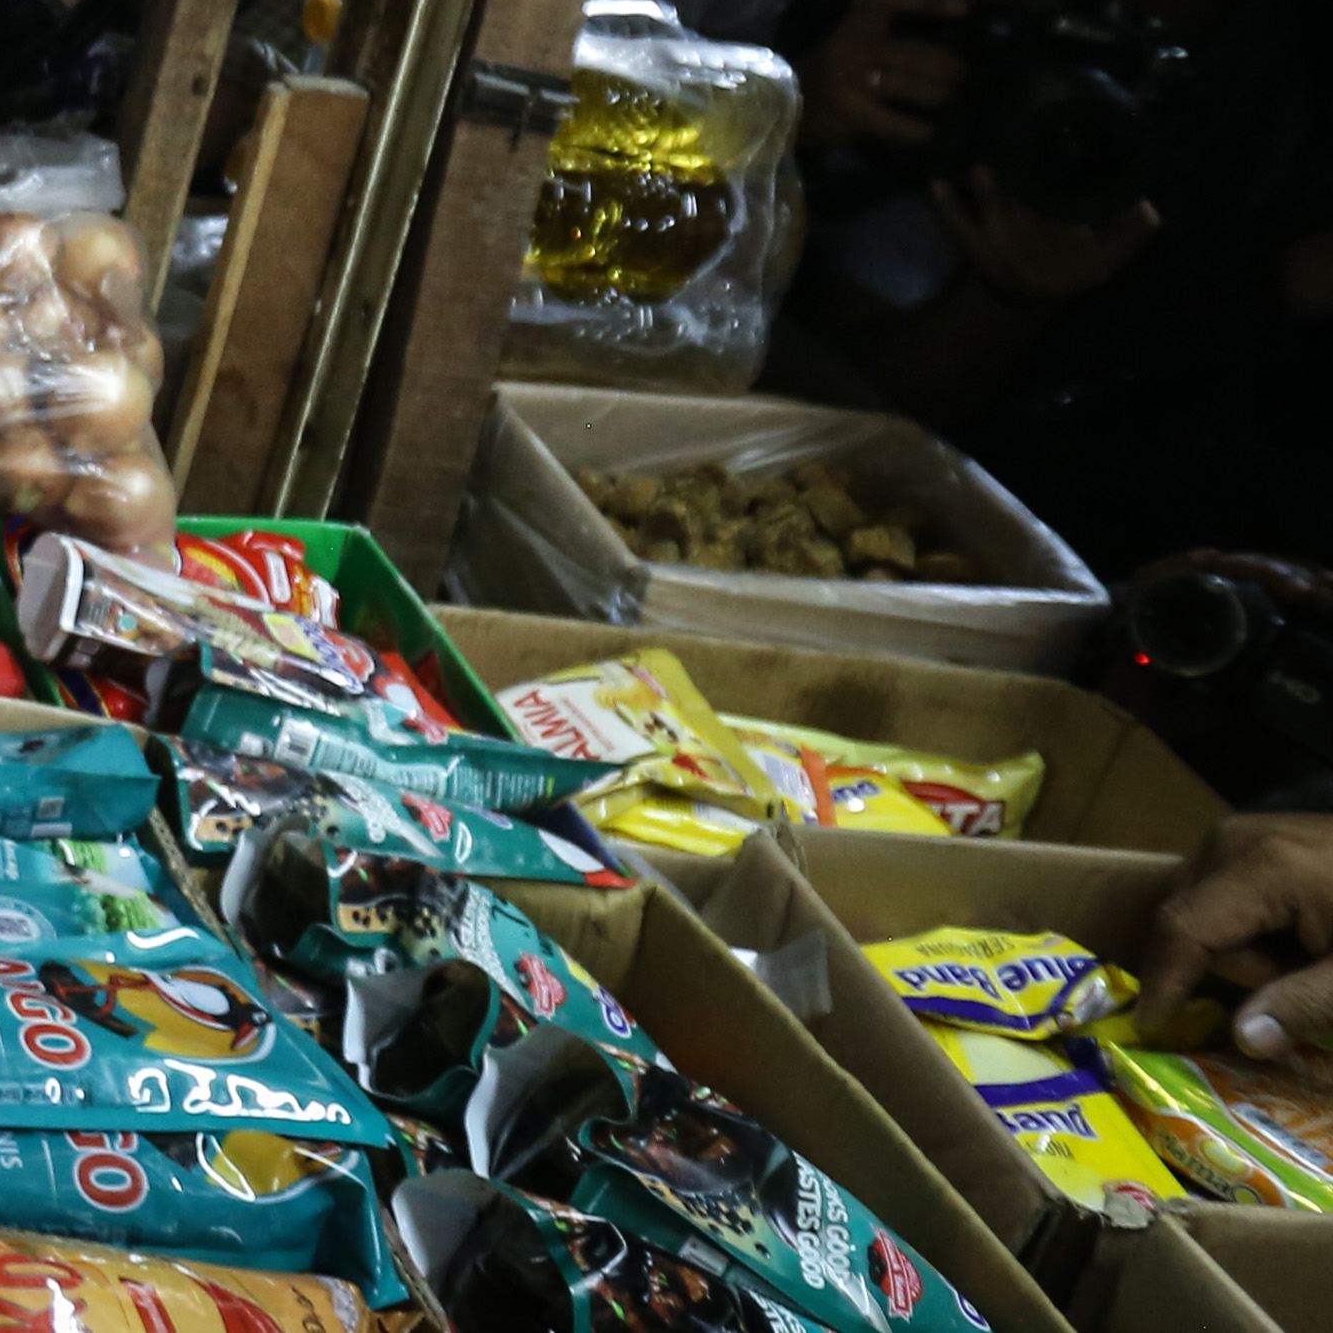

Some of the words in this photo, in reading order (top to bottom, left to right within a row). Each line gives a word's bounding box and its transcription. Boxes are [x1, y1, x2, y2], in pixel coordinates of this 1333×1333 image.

[513, 689, 601, 758] ALMIA
[894, 963, 1004, 1003] Band
[798, 1233, 826, 1289] GOOD
